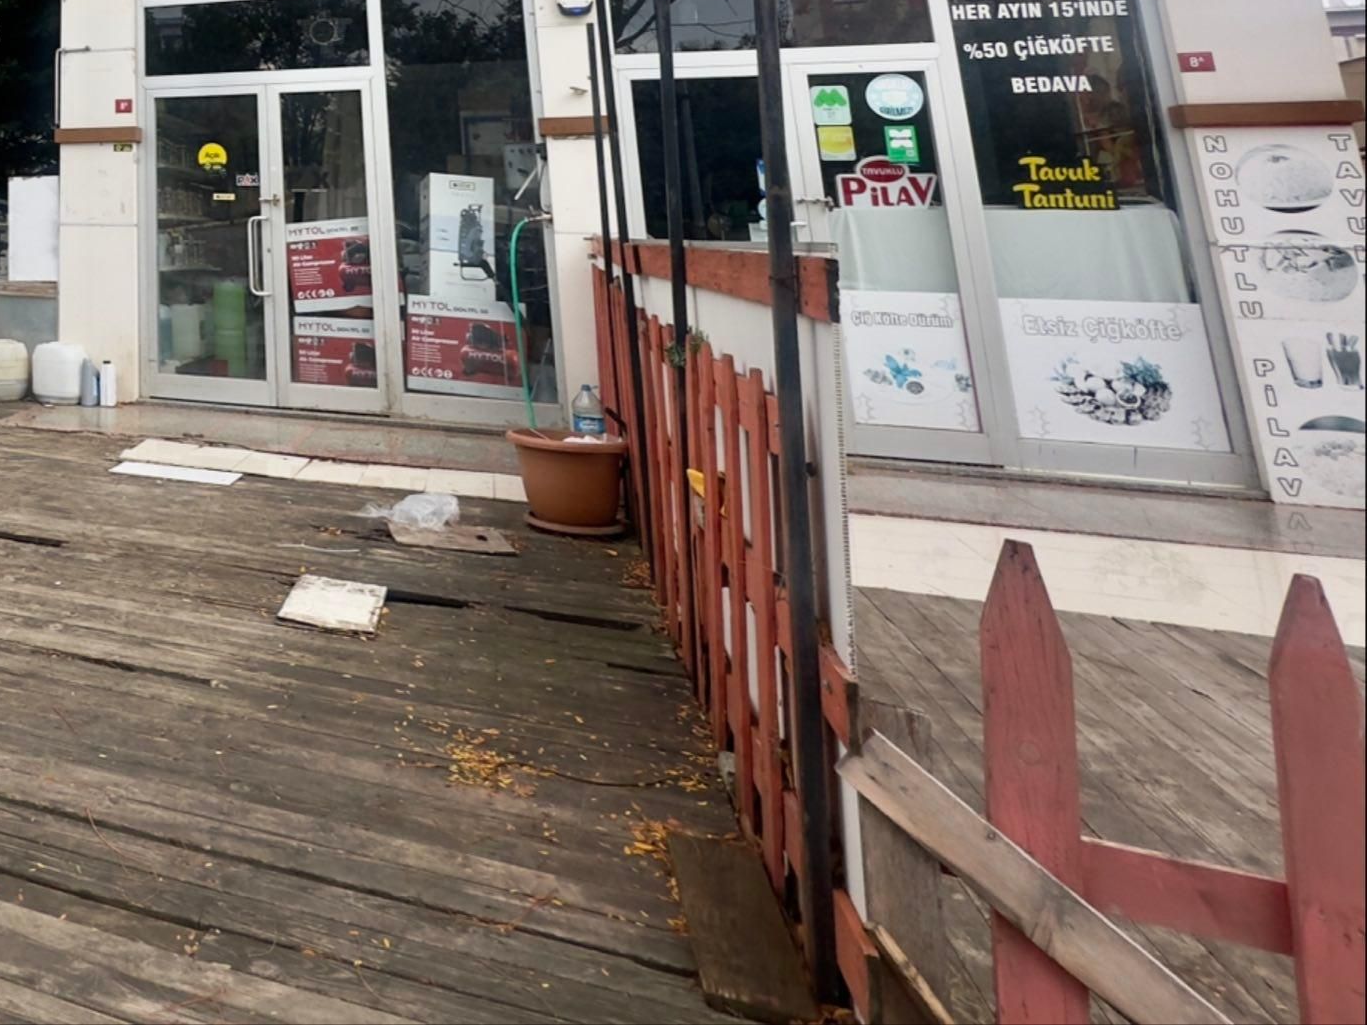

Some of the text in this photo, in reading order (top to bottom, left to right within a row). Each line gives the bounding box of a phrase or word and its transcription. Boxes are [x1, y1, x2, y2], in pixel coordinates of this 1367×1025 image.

[951, 3, 990, 21] HER
[996, 1, 1042, 20] AYIN
[963, 32, 1115, 62] %50 ÇİĞKÖFTE
[1010, 74, 1093, 94] BEDAVA
[1018, 155, 1101, 182] Tavuk
[1012, 182, 1115, 209] Tantuni
[1022, 314, 1184, 345] Etsiz Çiğköfte
